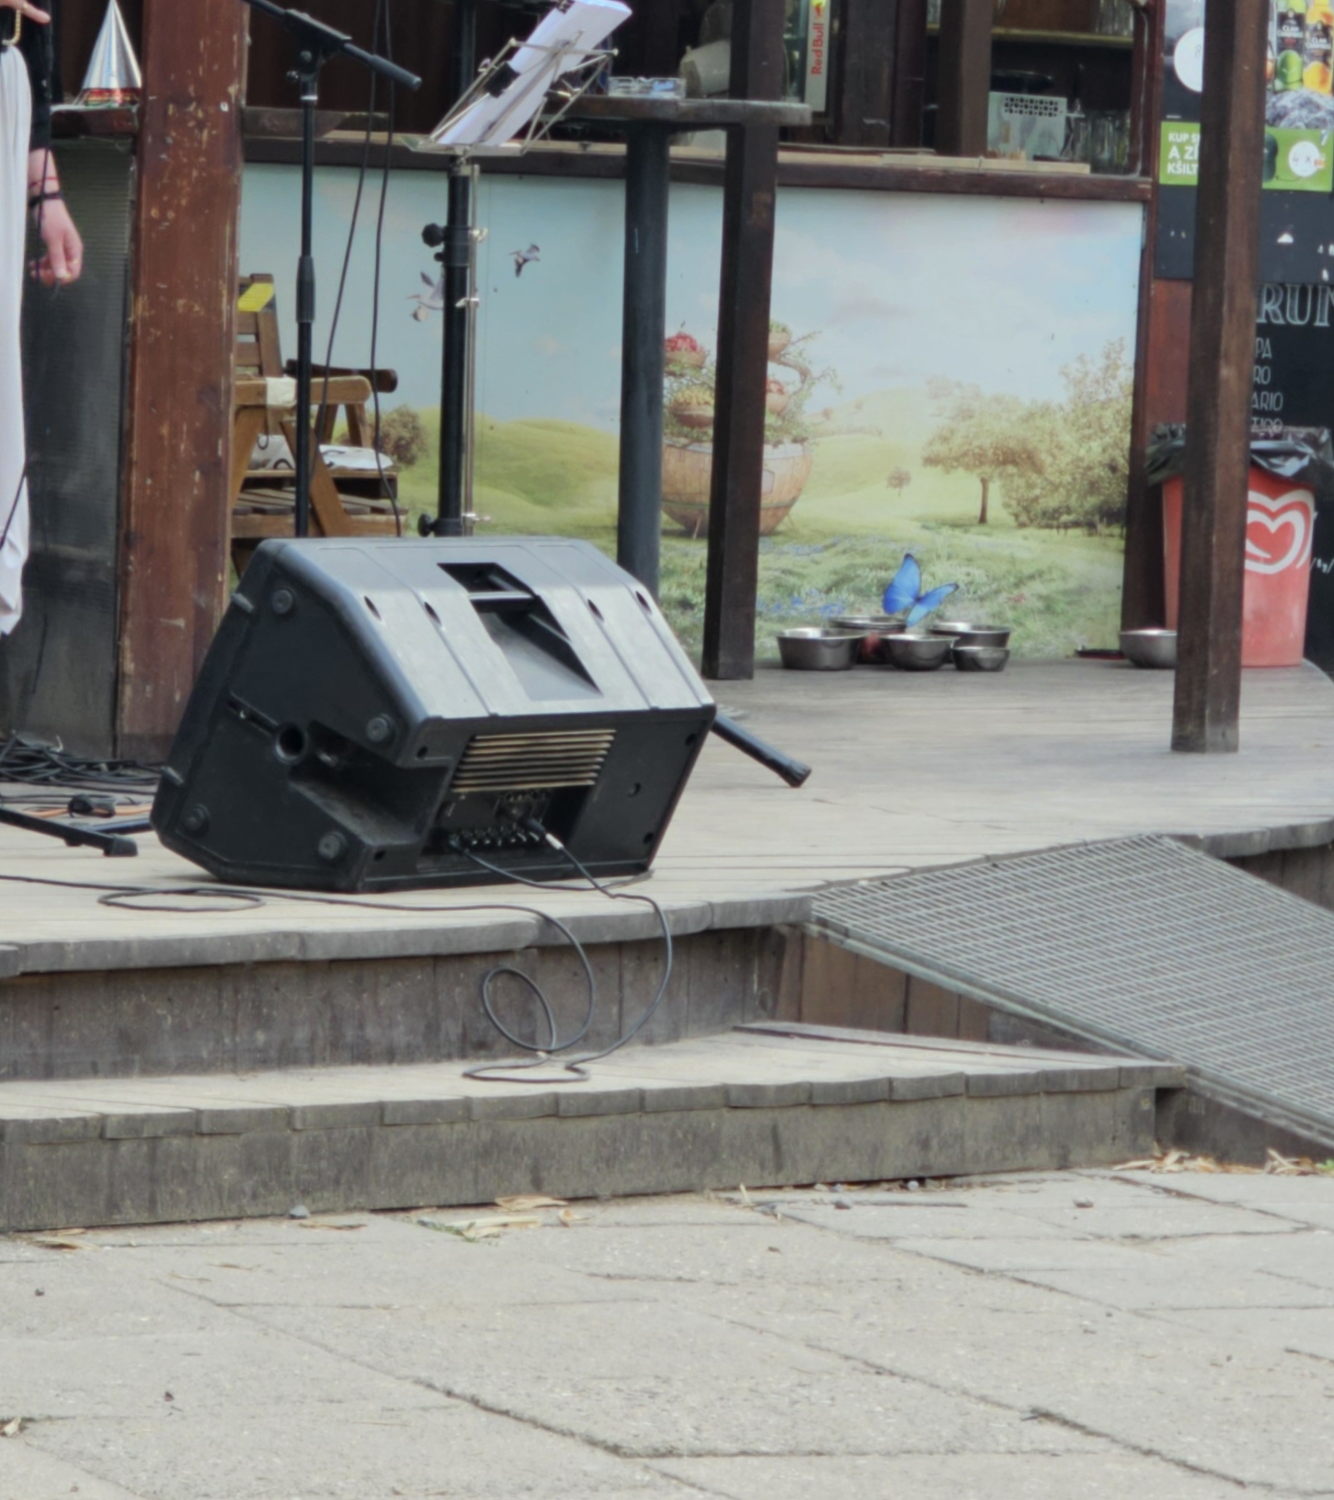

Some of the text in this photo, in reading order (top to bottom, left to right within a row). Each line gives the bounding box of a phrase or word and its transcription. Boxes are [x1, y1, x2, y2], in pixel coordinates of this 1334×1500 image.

[810, 22, 825, 76] Red Bull
[1169, 132, 1190, 143] KUP
[1168, 146, 1181, 160] A
